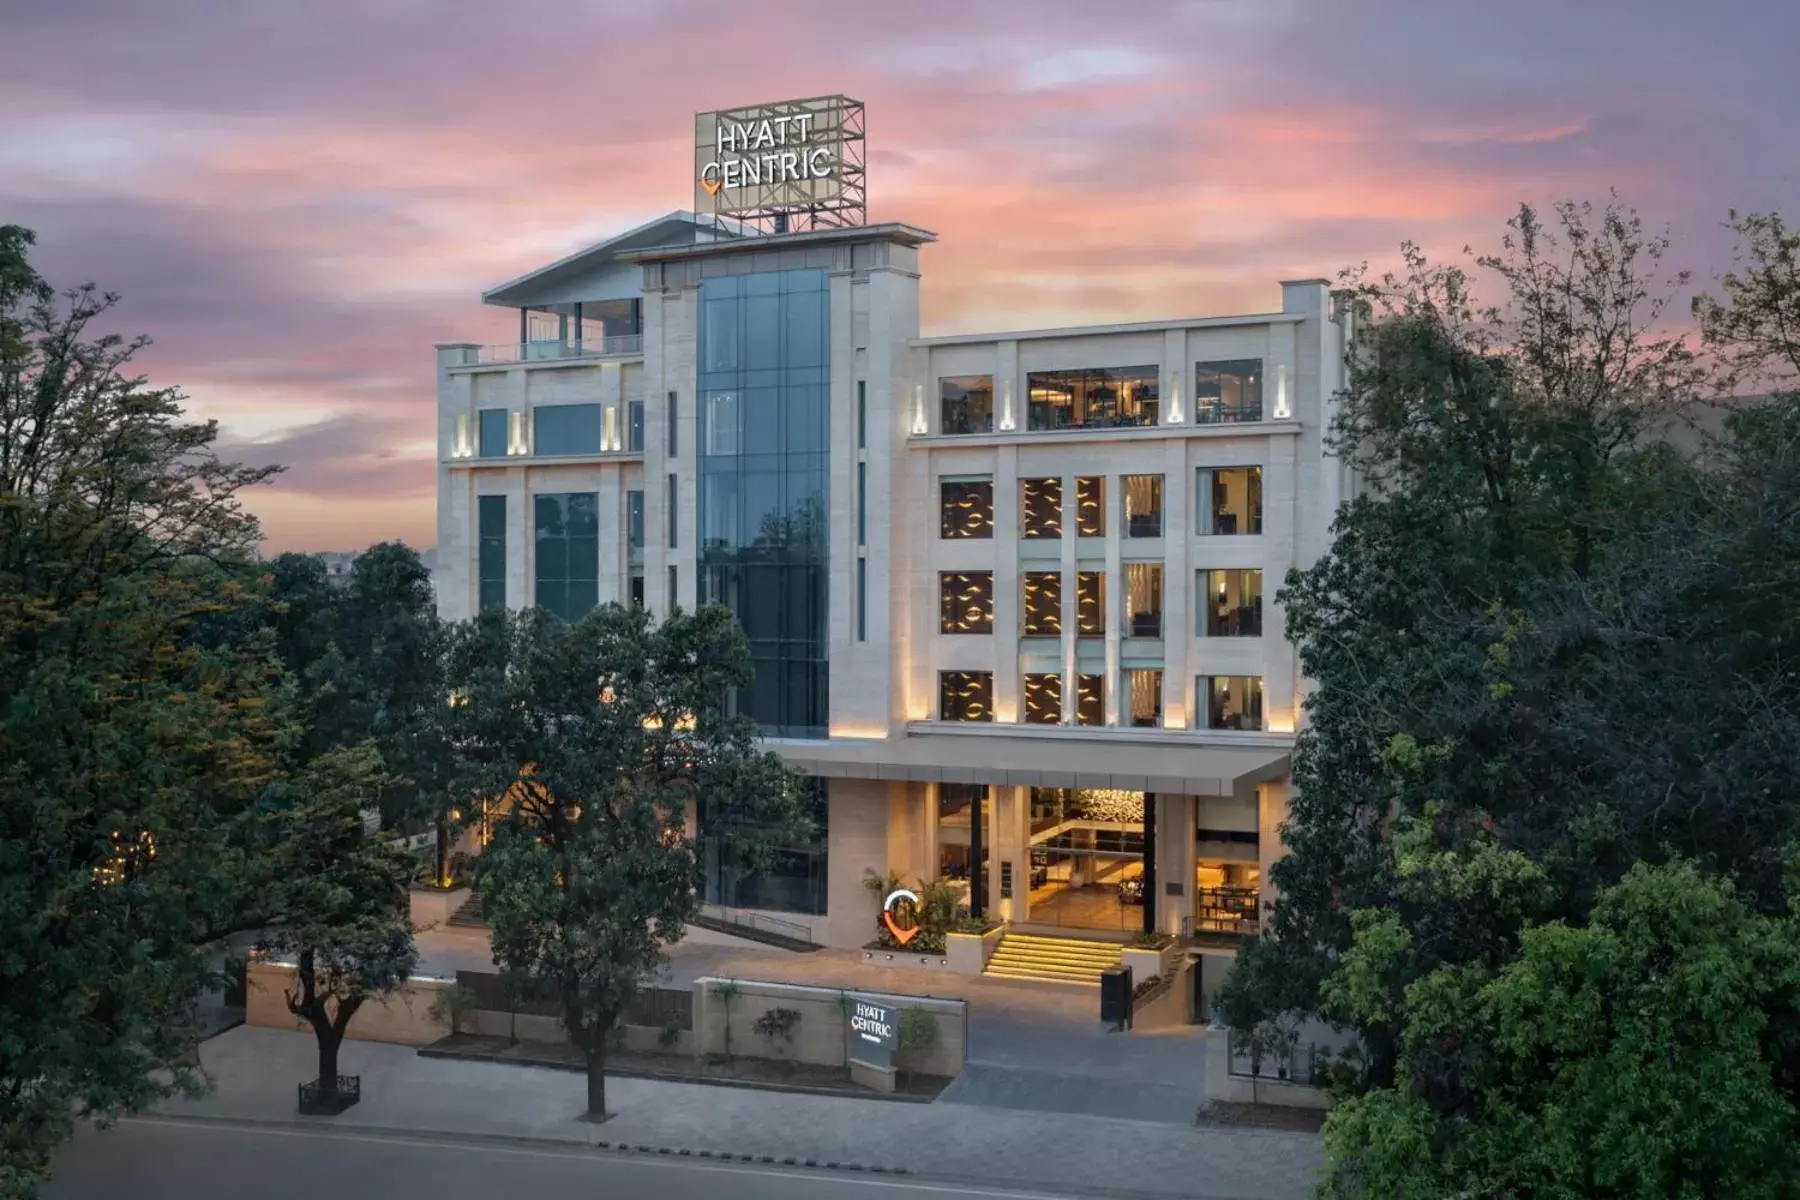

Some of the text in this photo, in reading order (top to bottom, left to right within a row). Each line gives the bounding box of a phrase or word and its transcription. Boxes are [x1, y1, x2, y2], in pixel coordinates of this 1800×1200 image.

[717, 113, 812, 153] HYATT
[701, 148, 831, 196] CENTRIC
[851, 1016, 892, 1037] CENTRIC
[857, 1003, 886, 1022] HYATT
